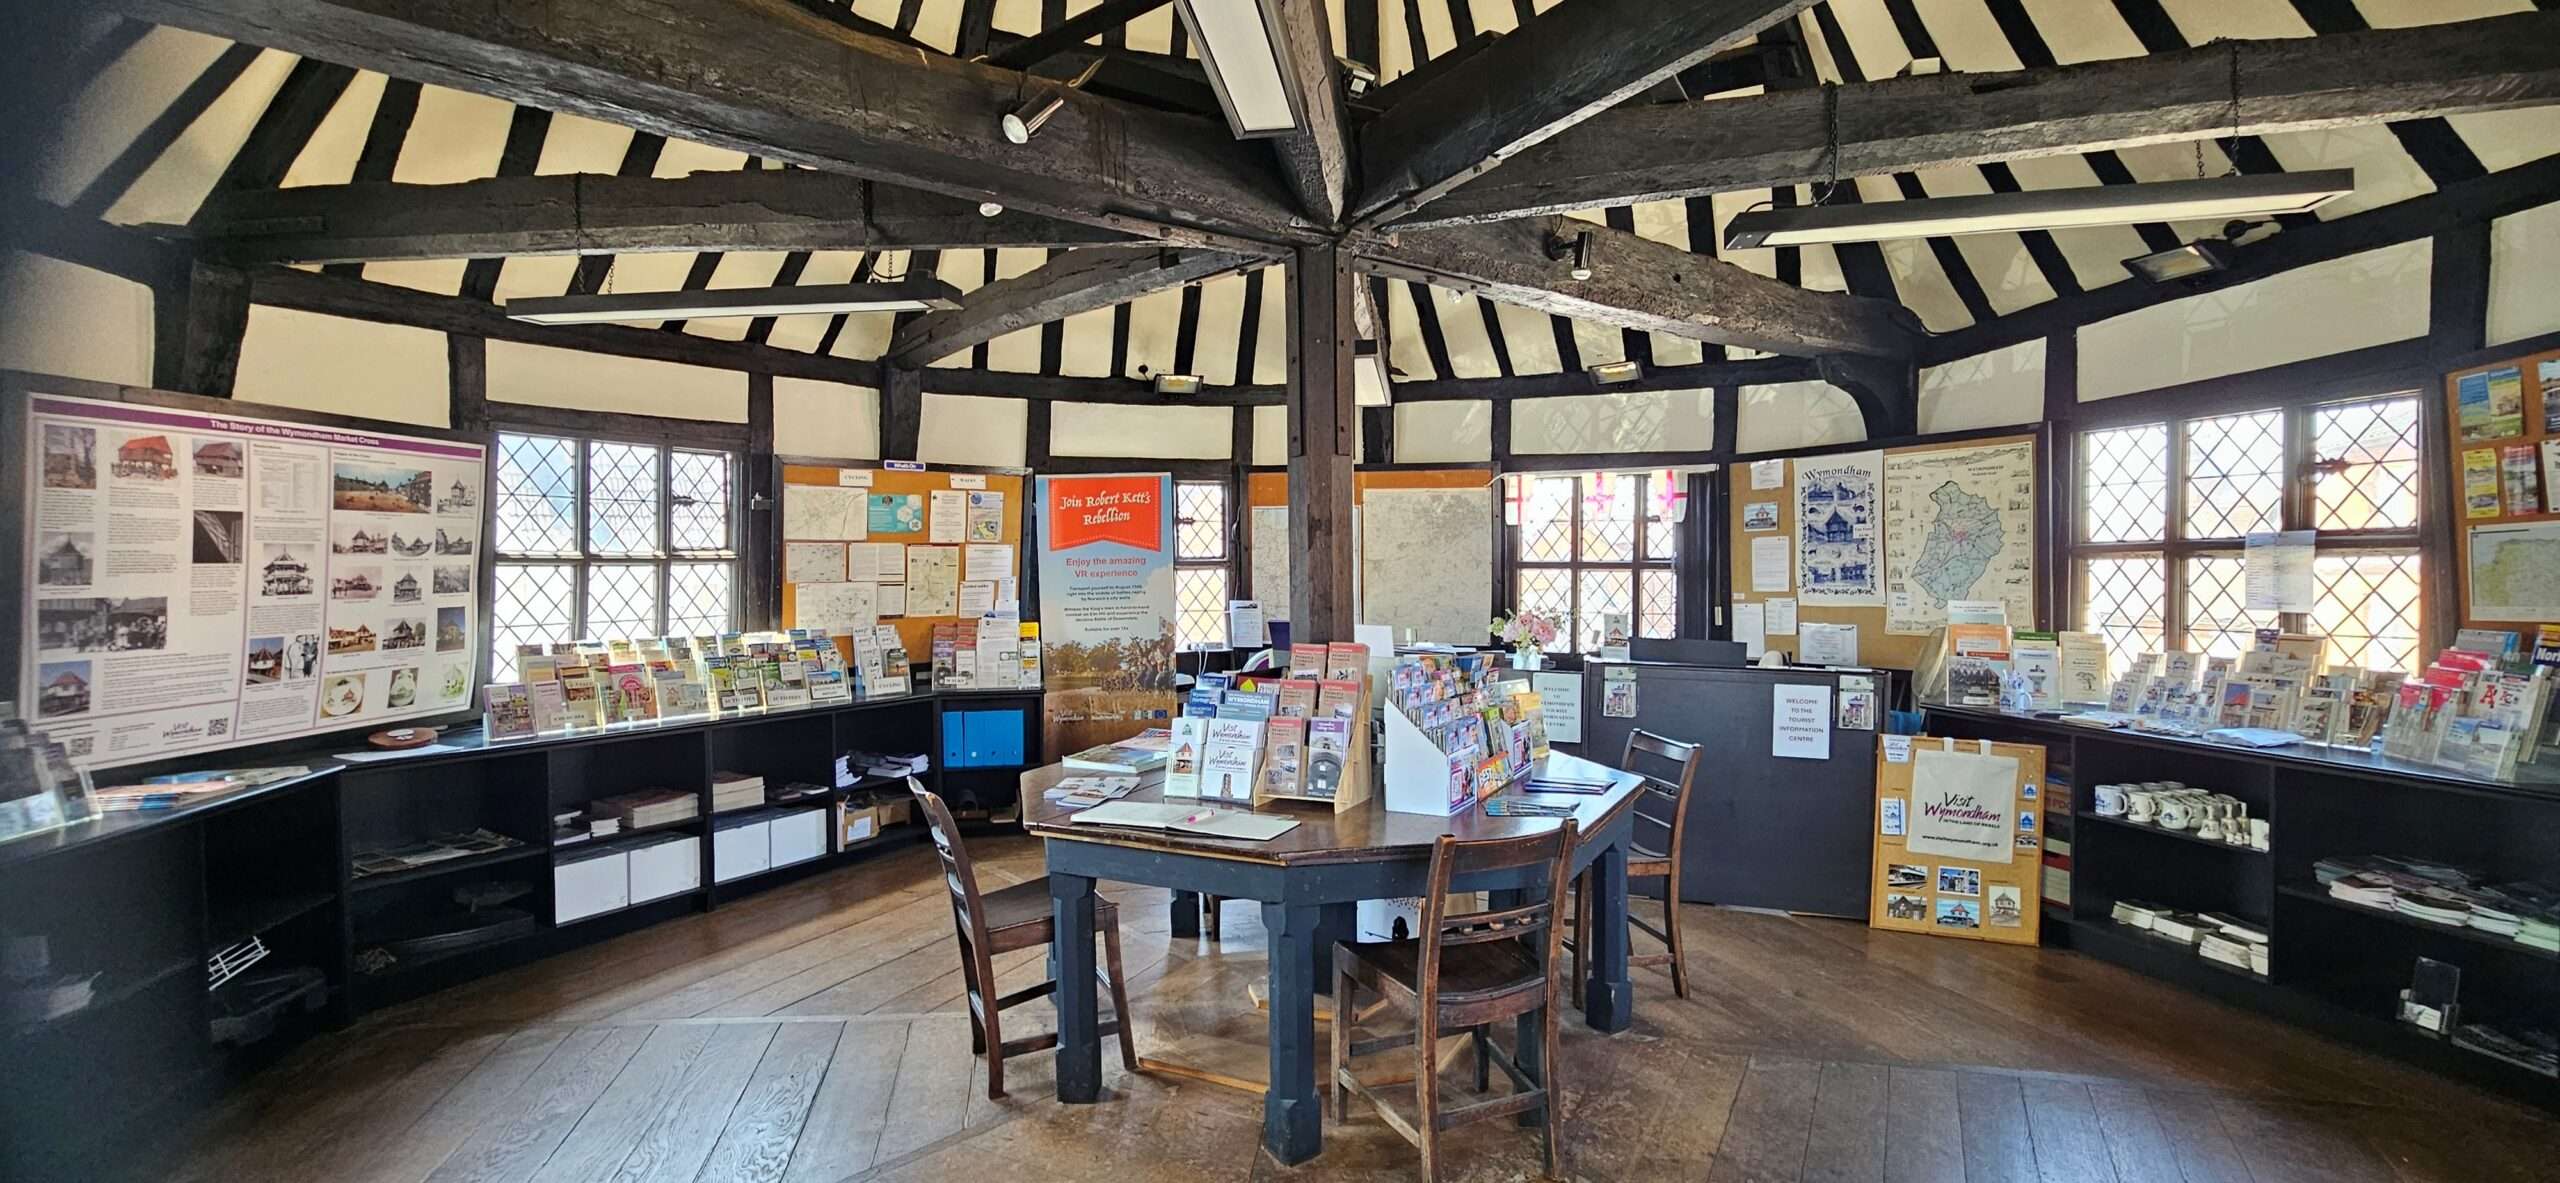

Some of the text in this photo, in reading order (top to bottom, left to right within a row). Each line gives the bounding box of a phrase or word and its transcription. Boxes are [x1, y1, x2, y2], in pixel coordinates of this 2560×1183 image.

[210, 419, 380, 446] The Story of the Wymondham Market Cross
[1802, 464, 1872, 481] Wymondham
[1059, 490, 1152, 510] Join Robert Kett's
[1083, 507, 1131, 525] Rebellion
[1066, 556, 1146, 568] Enjoy the amazing
[1090, 570, 1138, 578] experience
[1944, 791, 1975, 807] Visit
[1925, 801, 2001, 822] Wymondham
